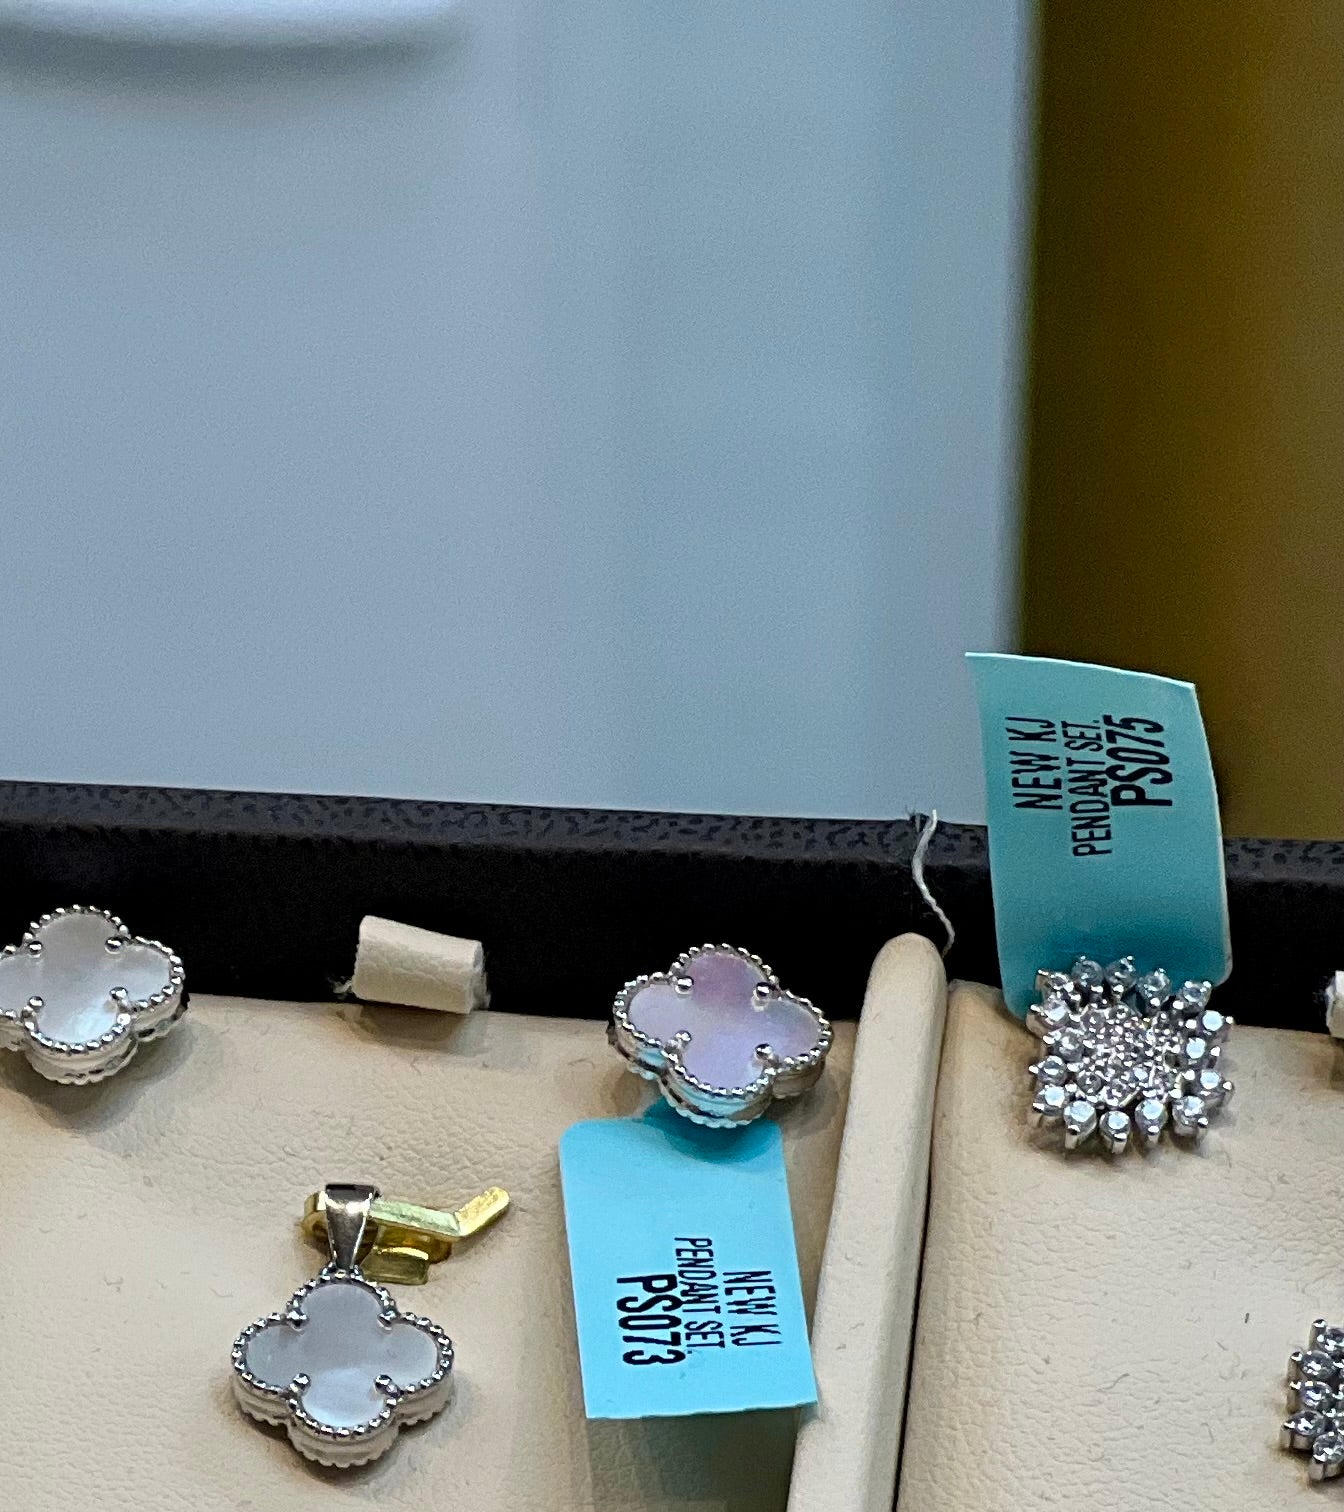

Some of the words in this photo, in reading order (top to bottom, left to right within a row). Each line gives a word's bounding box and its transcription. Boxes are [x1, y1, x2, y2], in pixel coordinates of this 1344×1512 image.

[1005, 716, 1057, 742] KJ
[1102, 714, 1174, 807] PS075
[1009, 750, 1063, 810] NEW
[1066, 756, 1113, 857] PENDANT
[674, 1236, 722, 1314] PENDANT
[722, 1270, 778, 1316] NEW
[616, 1273, 686, 1366] PS073
[730, 1323, 783, 1347] KJ
